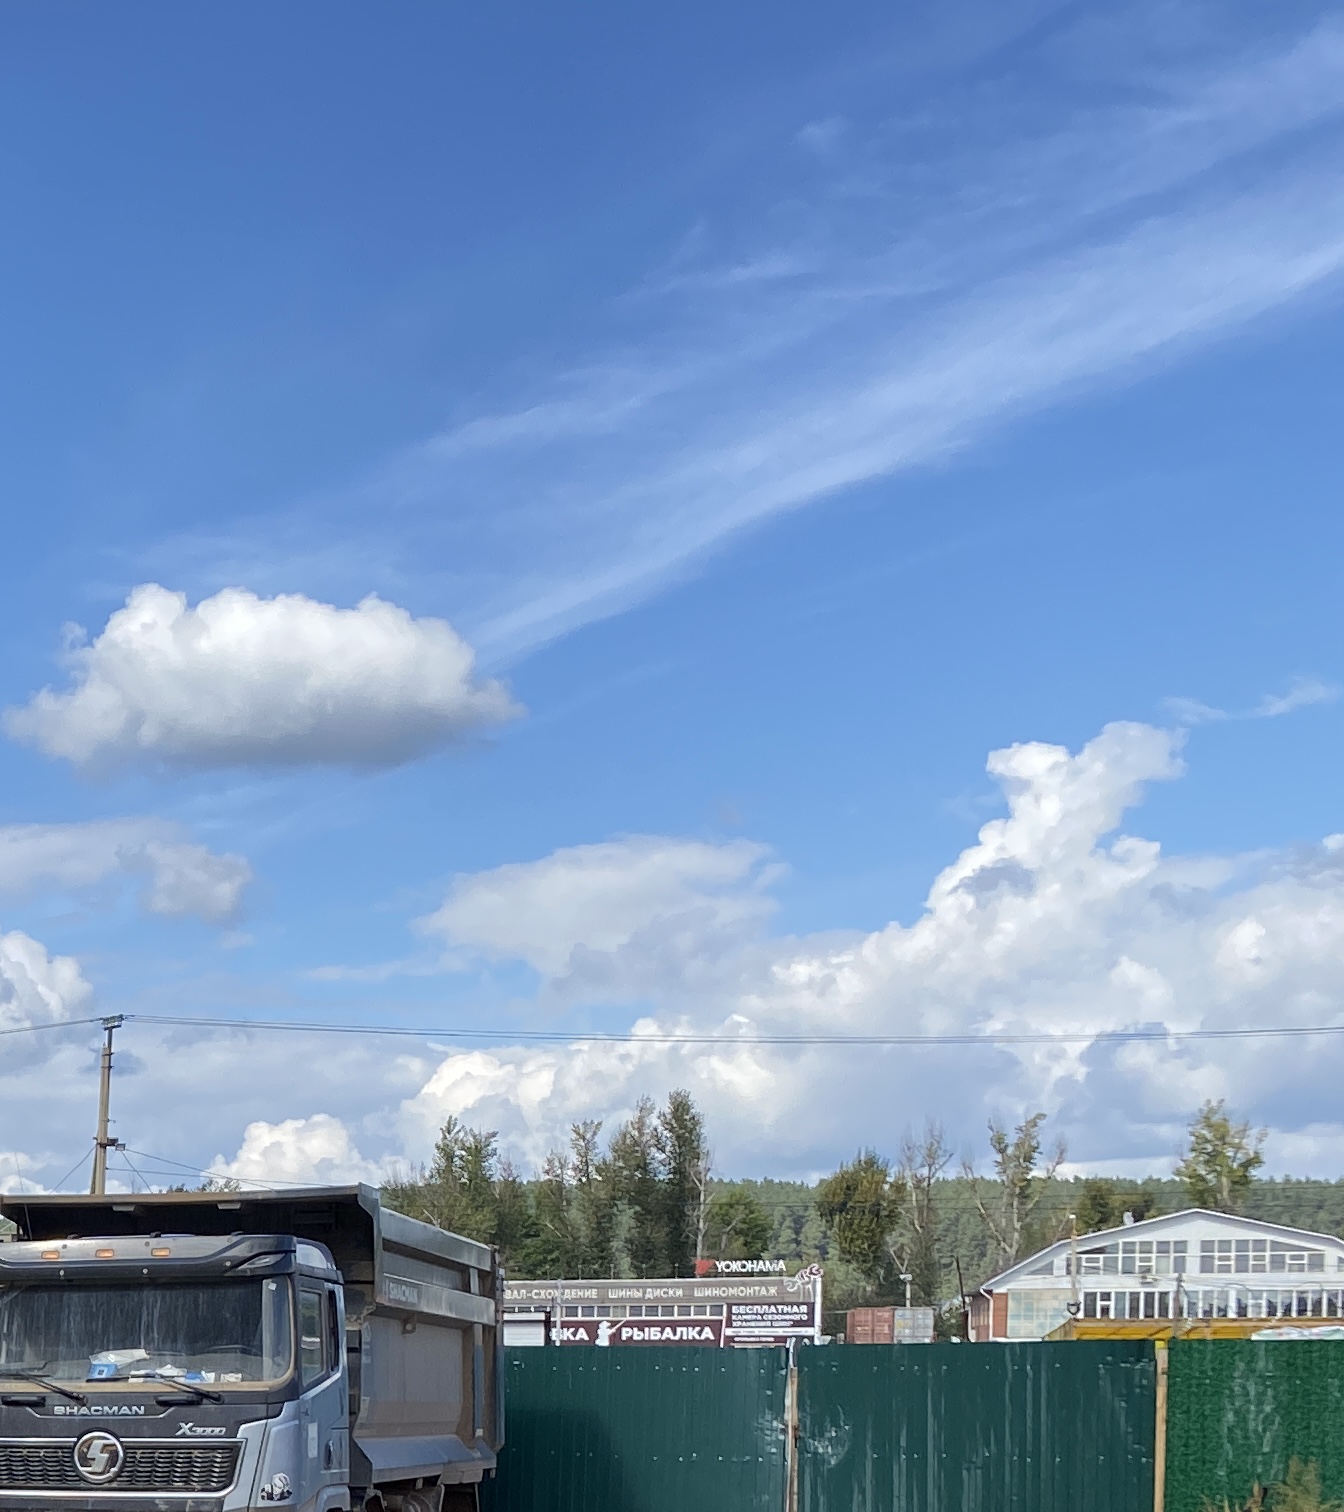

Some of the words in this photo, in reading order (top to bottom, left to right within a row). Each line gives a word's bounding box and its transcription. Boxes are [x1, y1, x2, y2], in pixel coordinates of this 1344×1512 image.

[715, 1259, 786, 1272] YOKOHAMA
[608, 1288, 642, 1298] ШИНЫ
[645, 1288, 683, 1299] ДИСКИ
[694, 1286, 778, 1297] ШИНОМОНТАЖ
[731, 1304, 808, 1314] БЕСПЛАТНАЯ
[621, 1326, 715, 1341] РЫБАЛКА
[53, 1405, 145, 1416] SHACMAN
[175, 1422, 227, 1436] X3000
